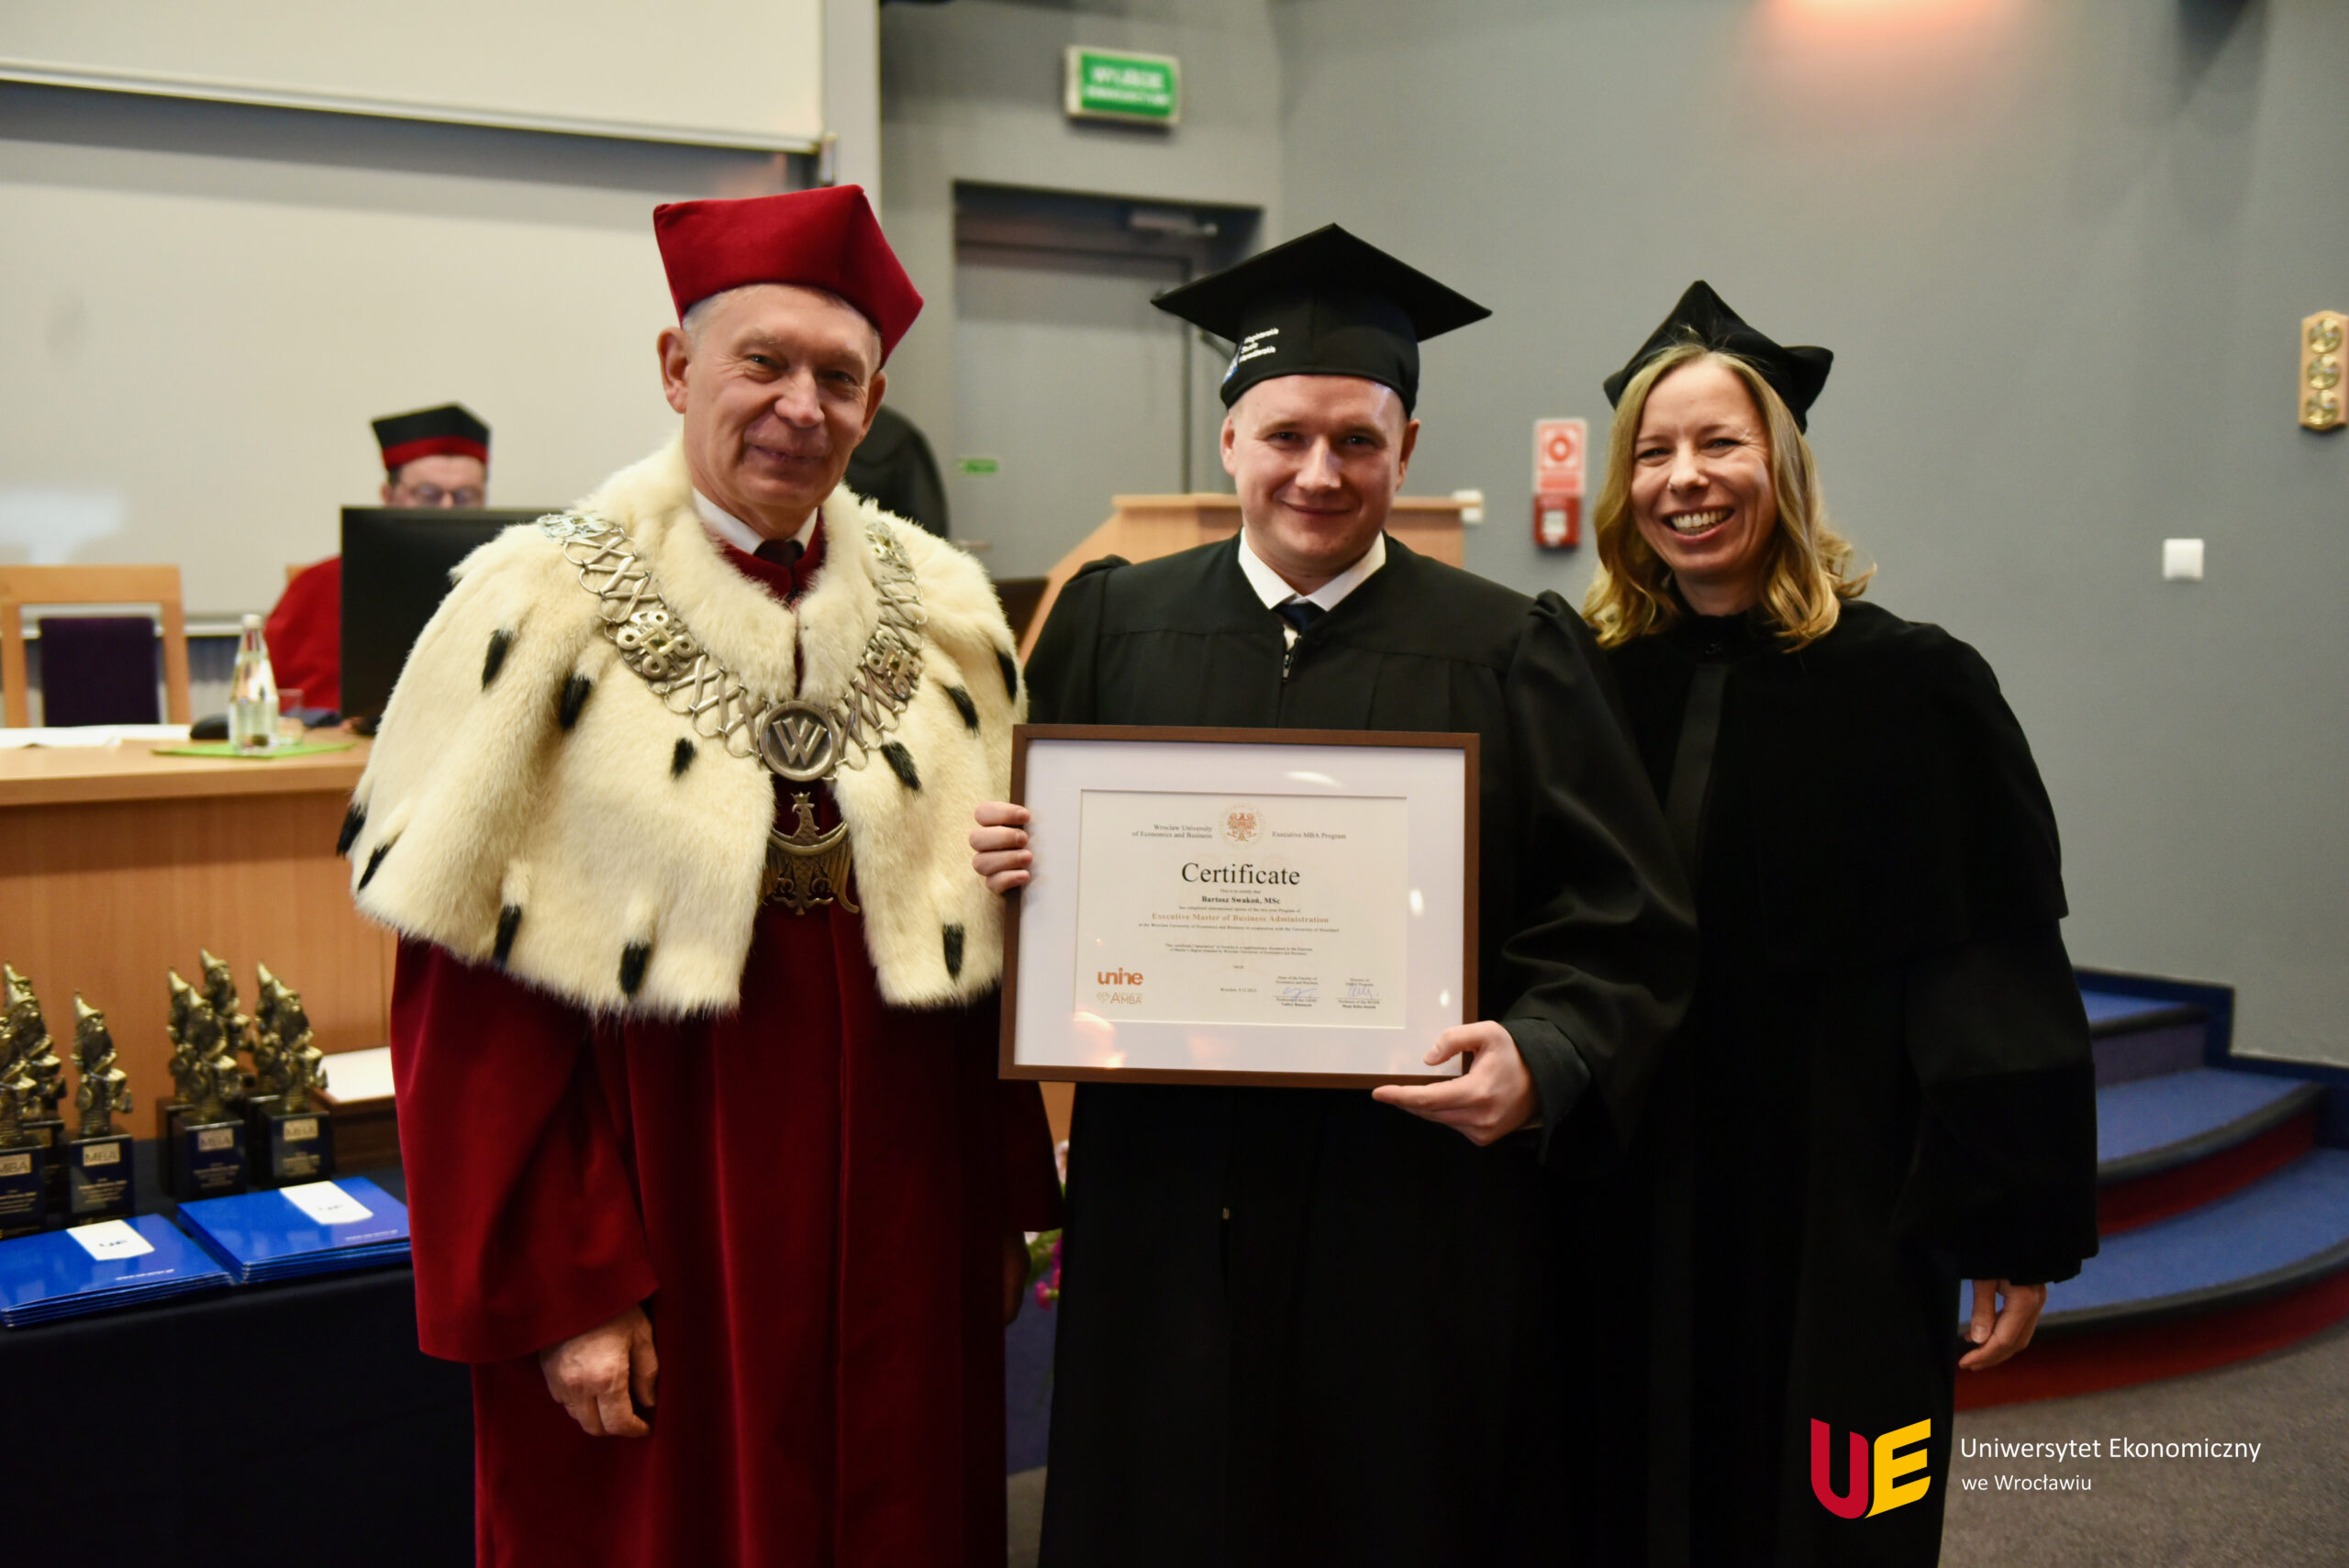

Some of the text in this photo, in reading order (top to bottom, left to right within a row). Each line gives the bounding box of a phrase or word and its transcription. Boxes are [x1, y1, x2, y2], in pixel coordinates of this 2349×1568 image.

[1181, 862, 1300, 885] Certificate
[1201, 895, 1230, 904] Bartosz
[1152, 912, 1190, 920] Executive
[1192, 913, 1219, 921] Master
[1232, 914, 1267, 922] Business
[1270, 915, 1330, 924] Administration
[1110, 991, 1143, 1005] AMBA
